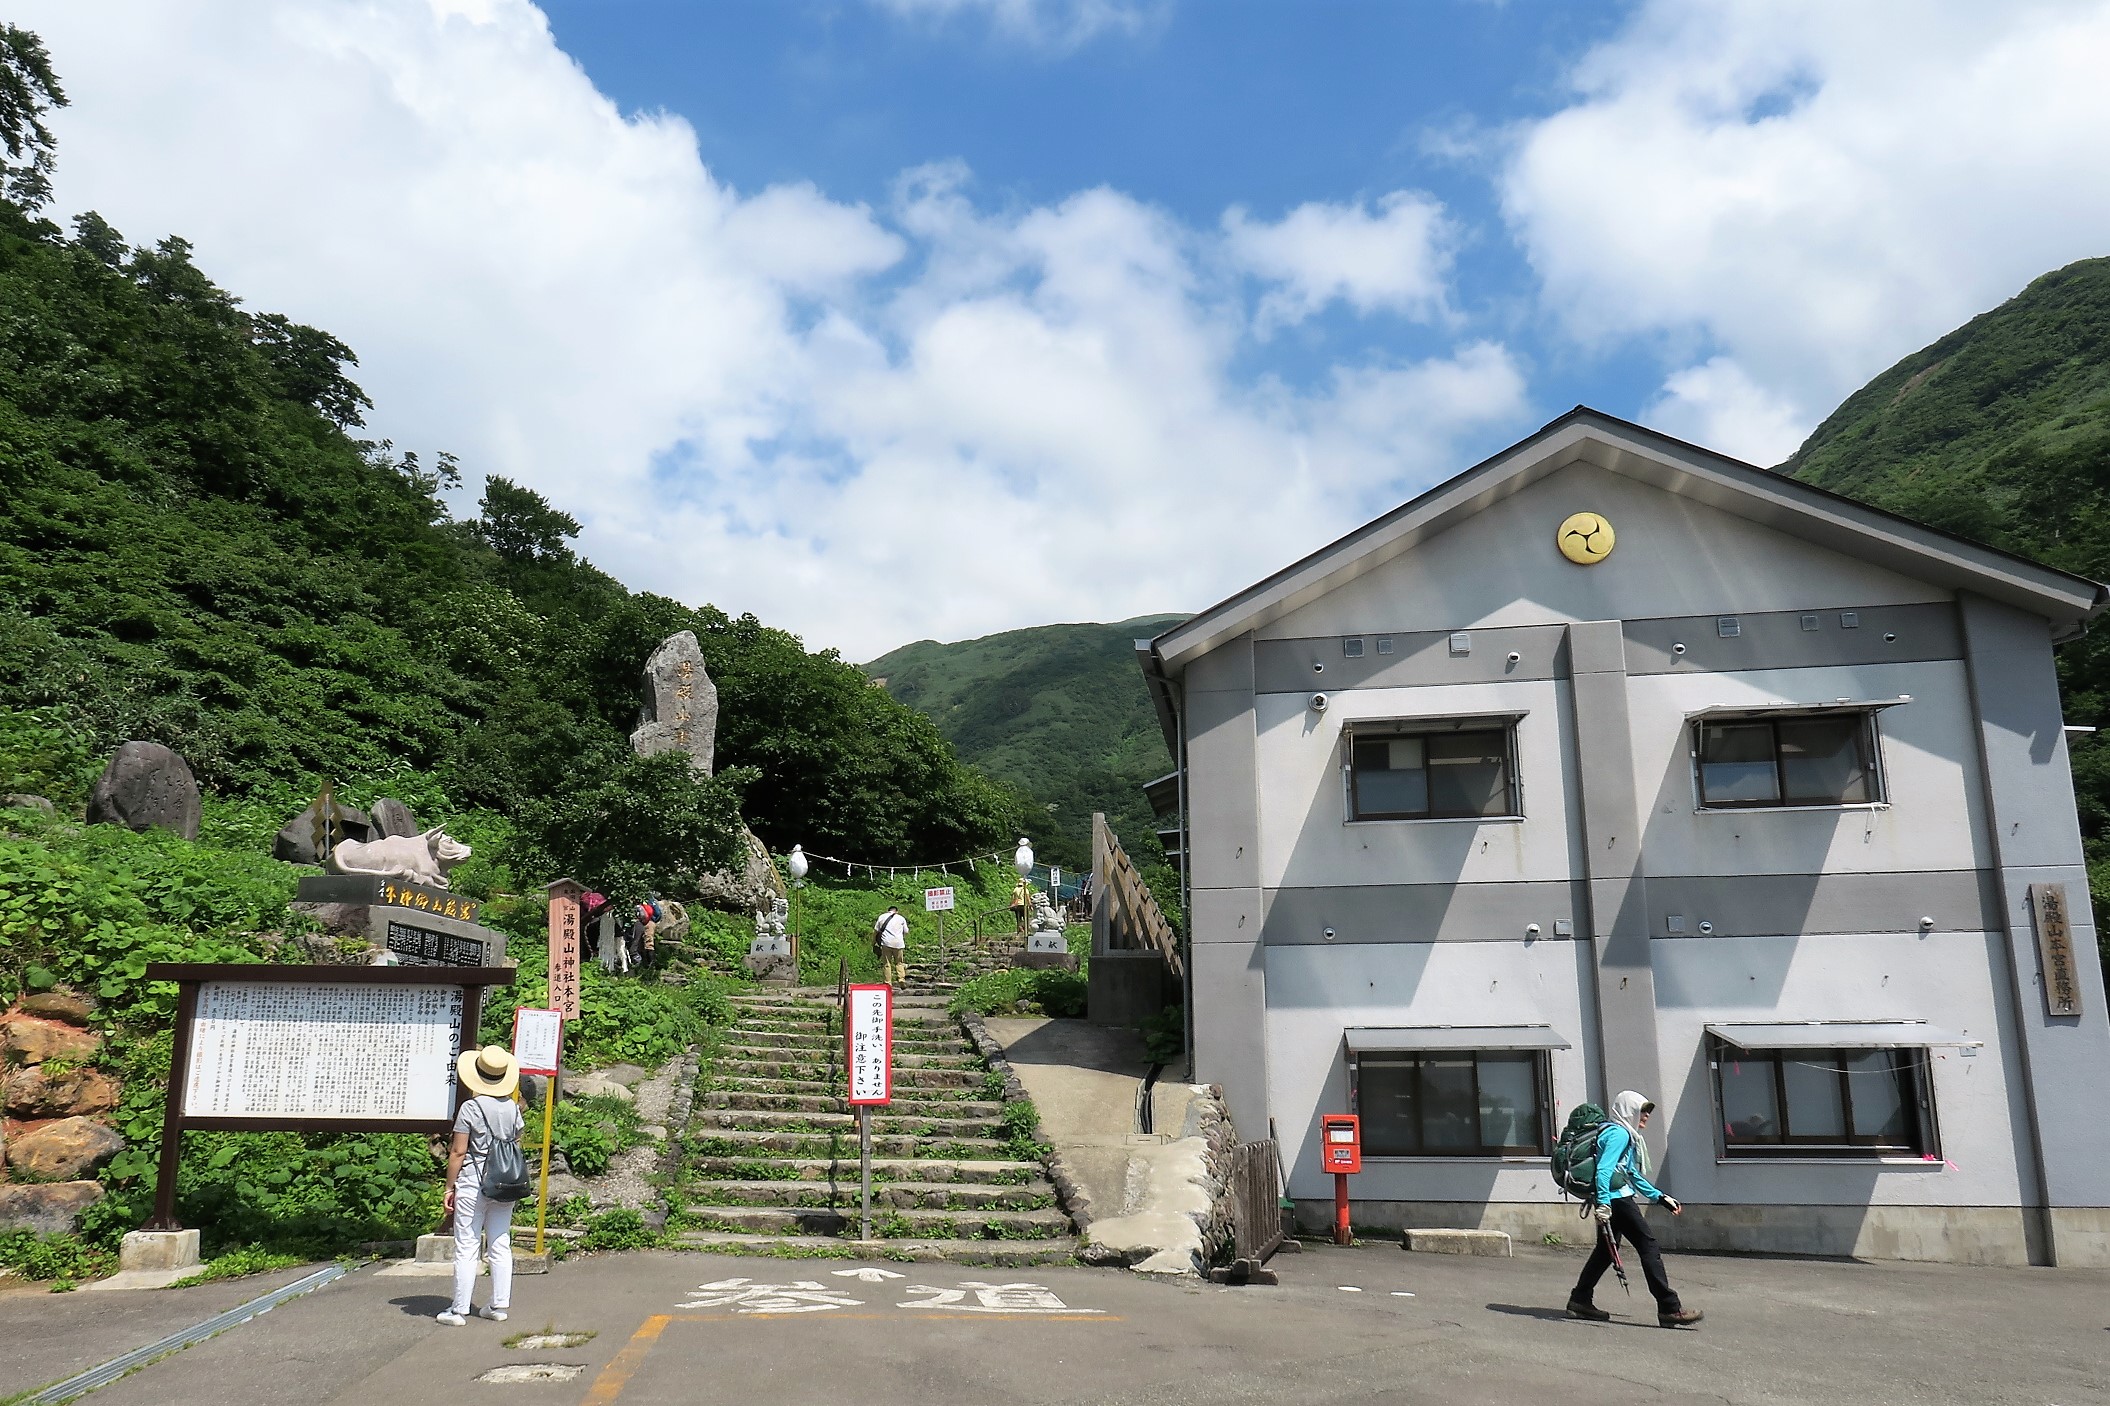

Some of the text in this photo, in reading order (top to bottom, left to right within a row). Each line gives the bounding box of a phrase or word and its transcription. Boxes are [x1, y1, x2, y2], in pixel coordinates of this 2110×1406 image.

[553, 962, 562, 1003] 参道入口
[562, 913, 576, 1013] 湯殿山神社本宮
[445, 989, 463, 1086] 湯殿山のご由来
[855, 1031, 868, 1096] 御注意下さい
[872, 994, 884, 1096] この先御手洗い、ありません
[673, 1277, 1107, 1314] 参道
